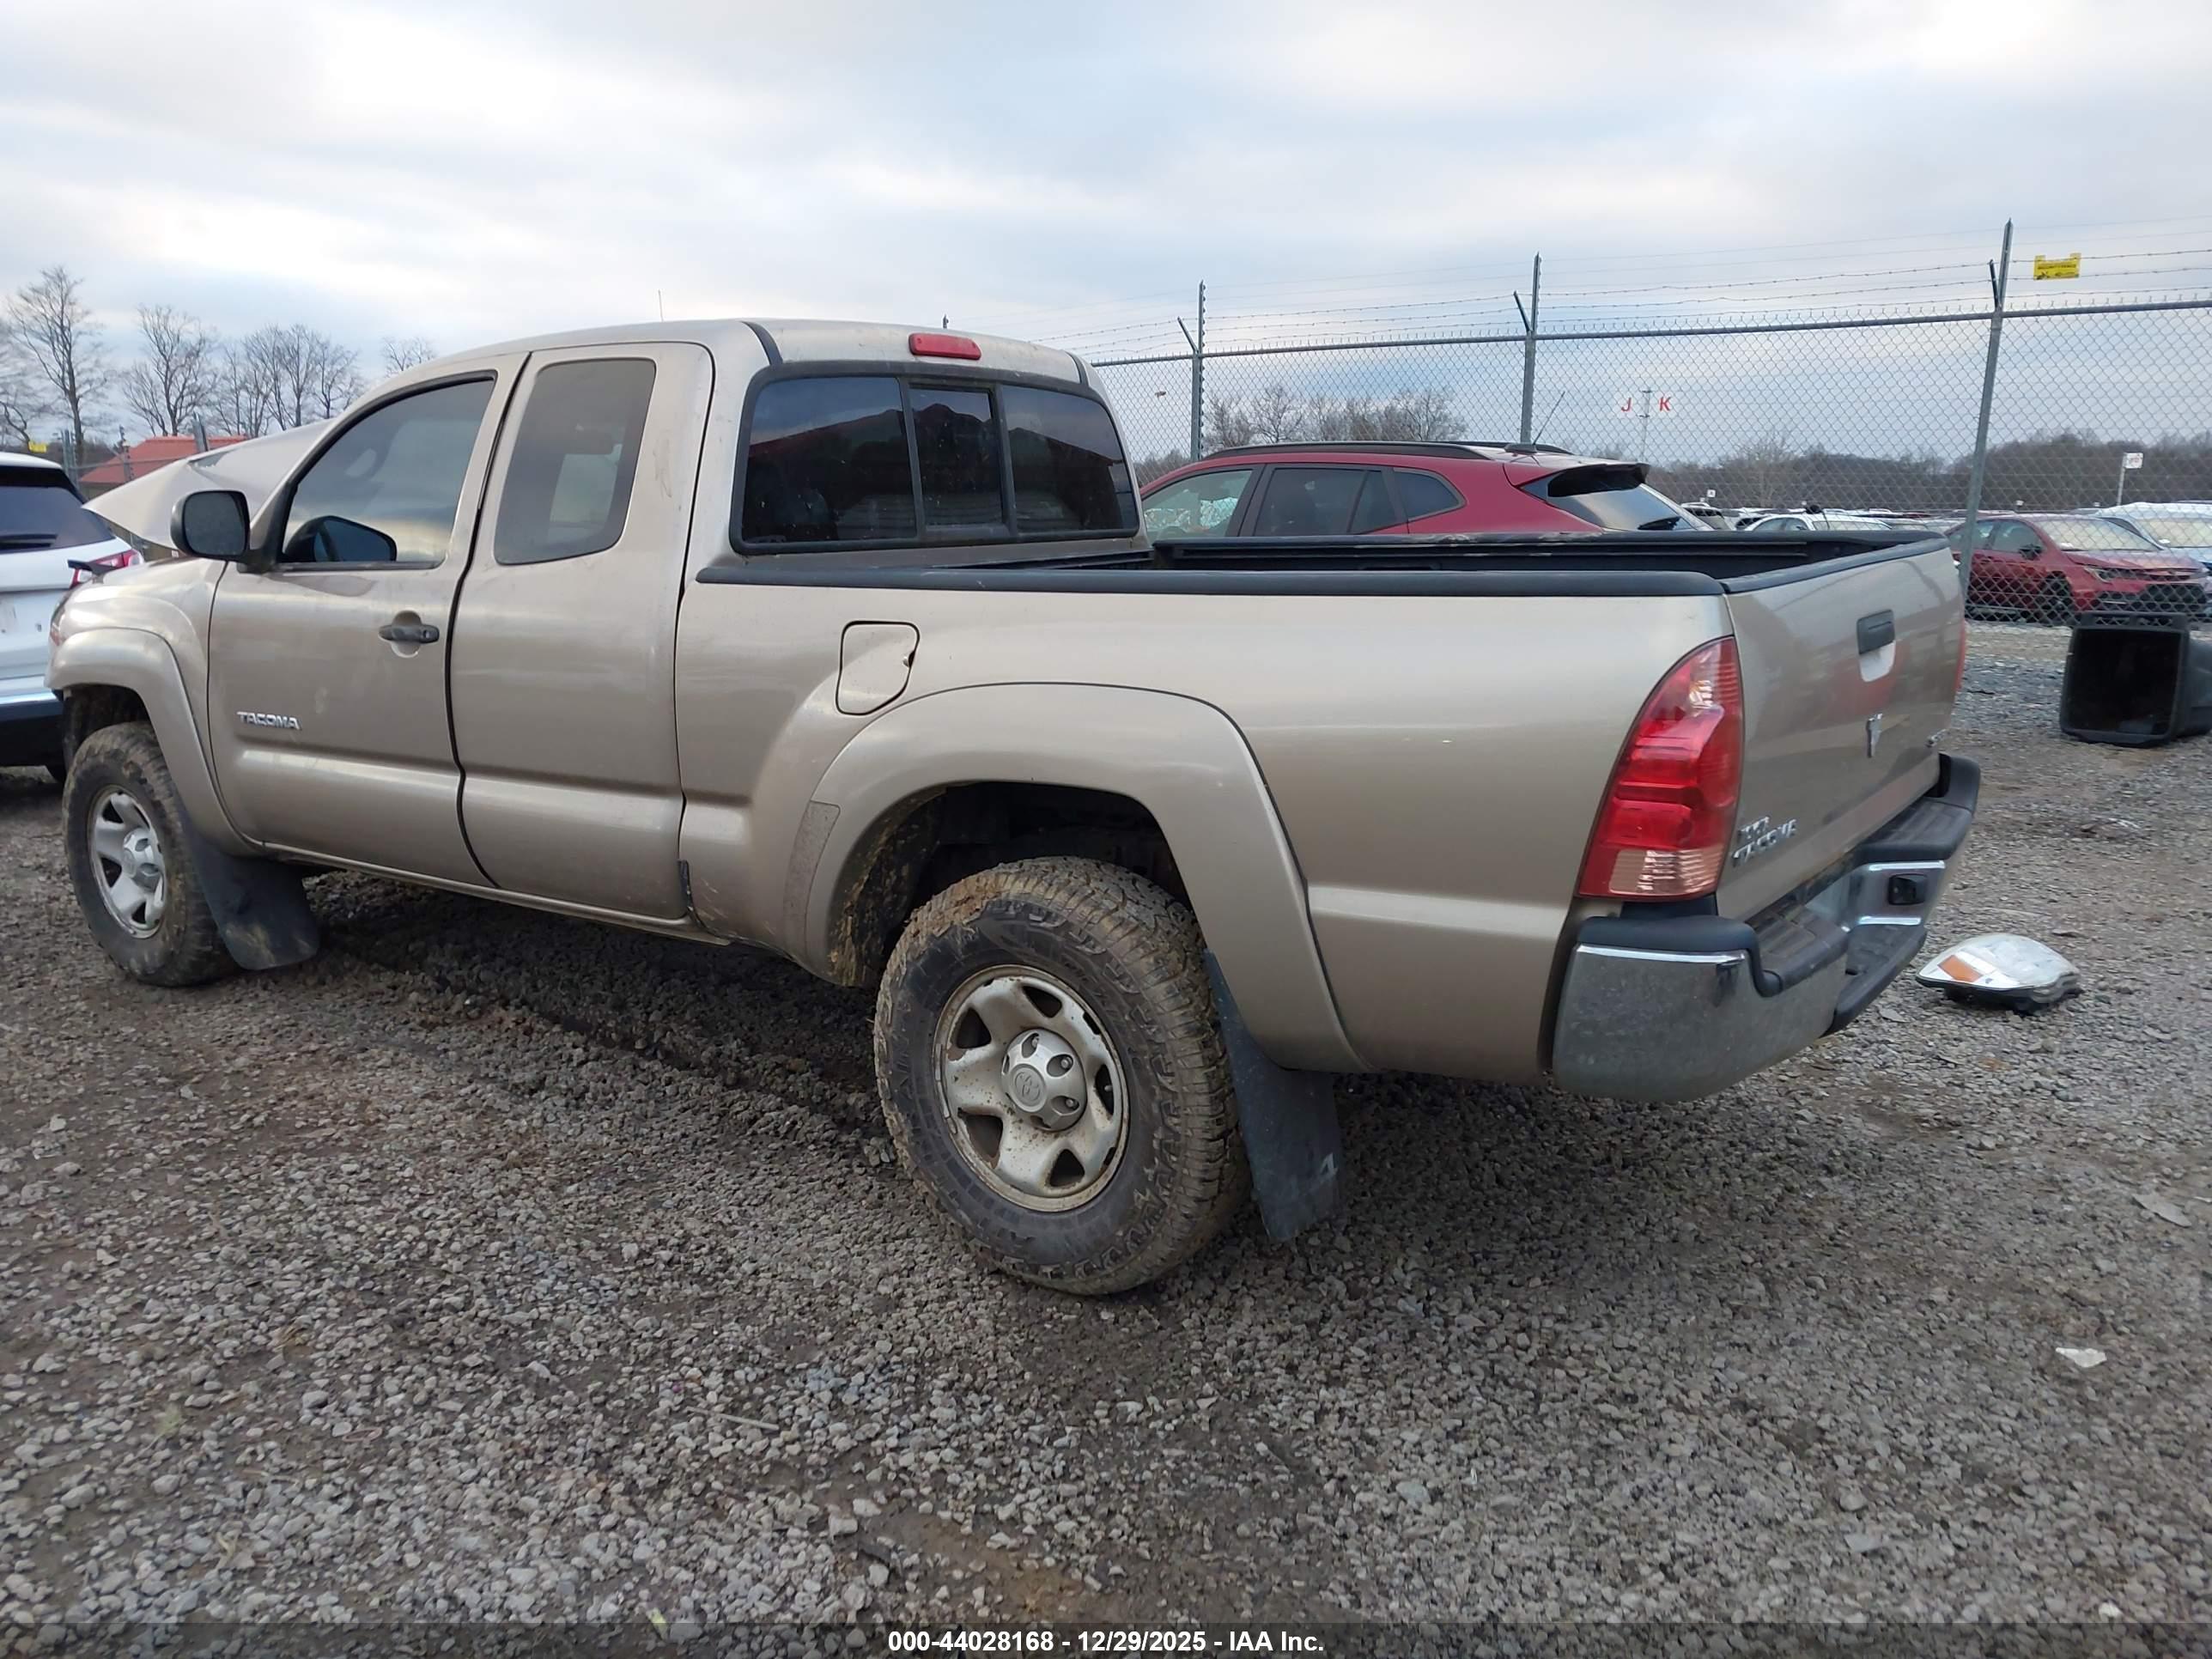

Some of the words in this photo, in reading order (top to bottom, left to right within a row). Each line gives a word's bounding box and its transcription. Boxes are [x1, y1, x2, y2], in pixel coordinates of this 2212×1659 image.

[1620, 397, 1632, 412] J
[1659, 396, 1672, 411] K
[236, 711, 301, 730] TACOMA
